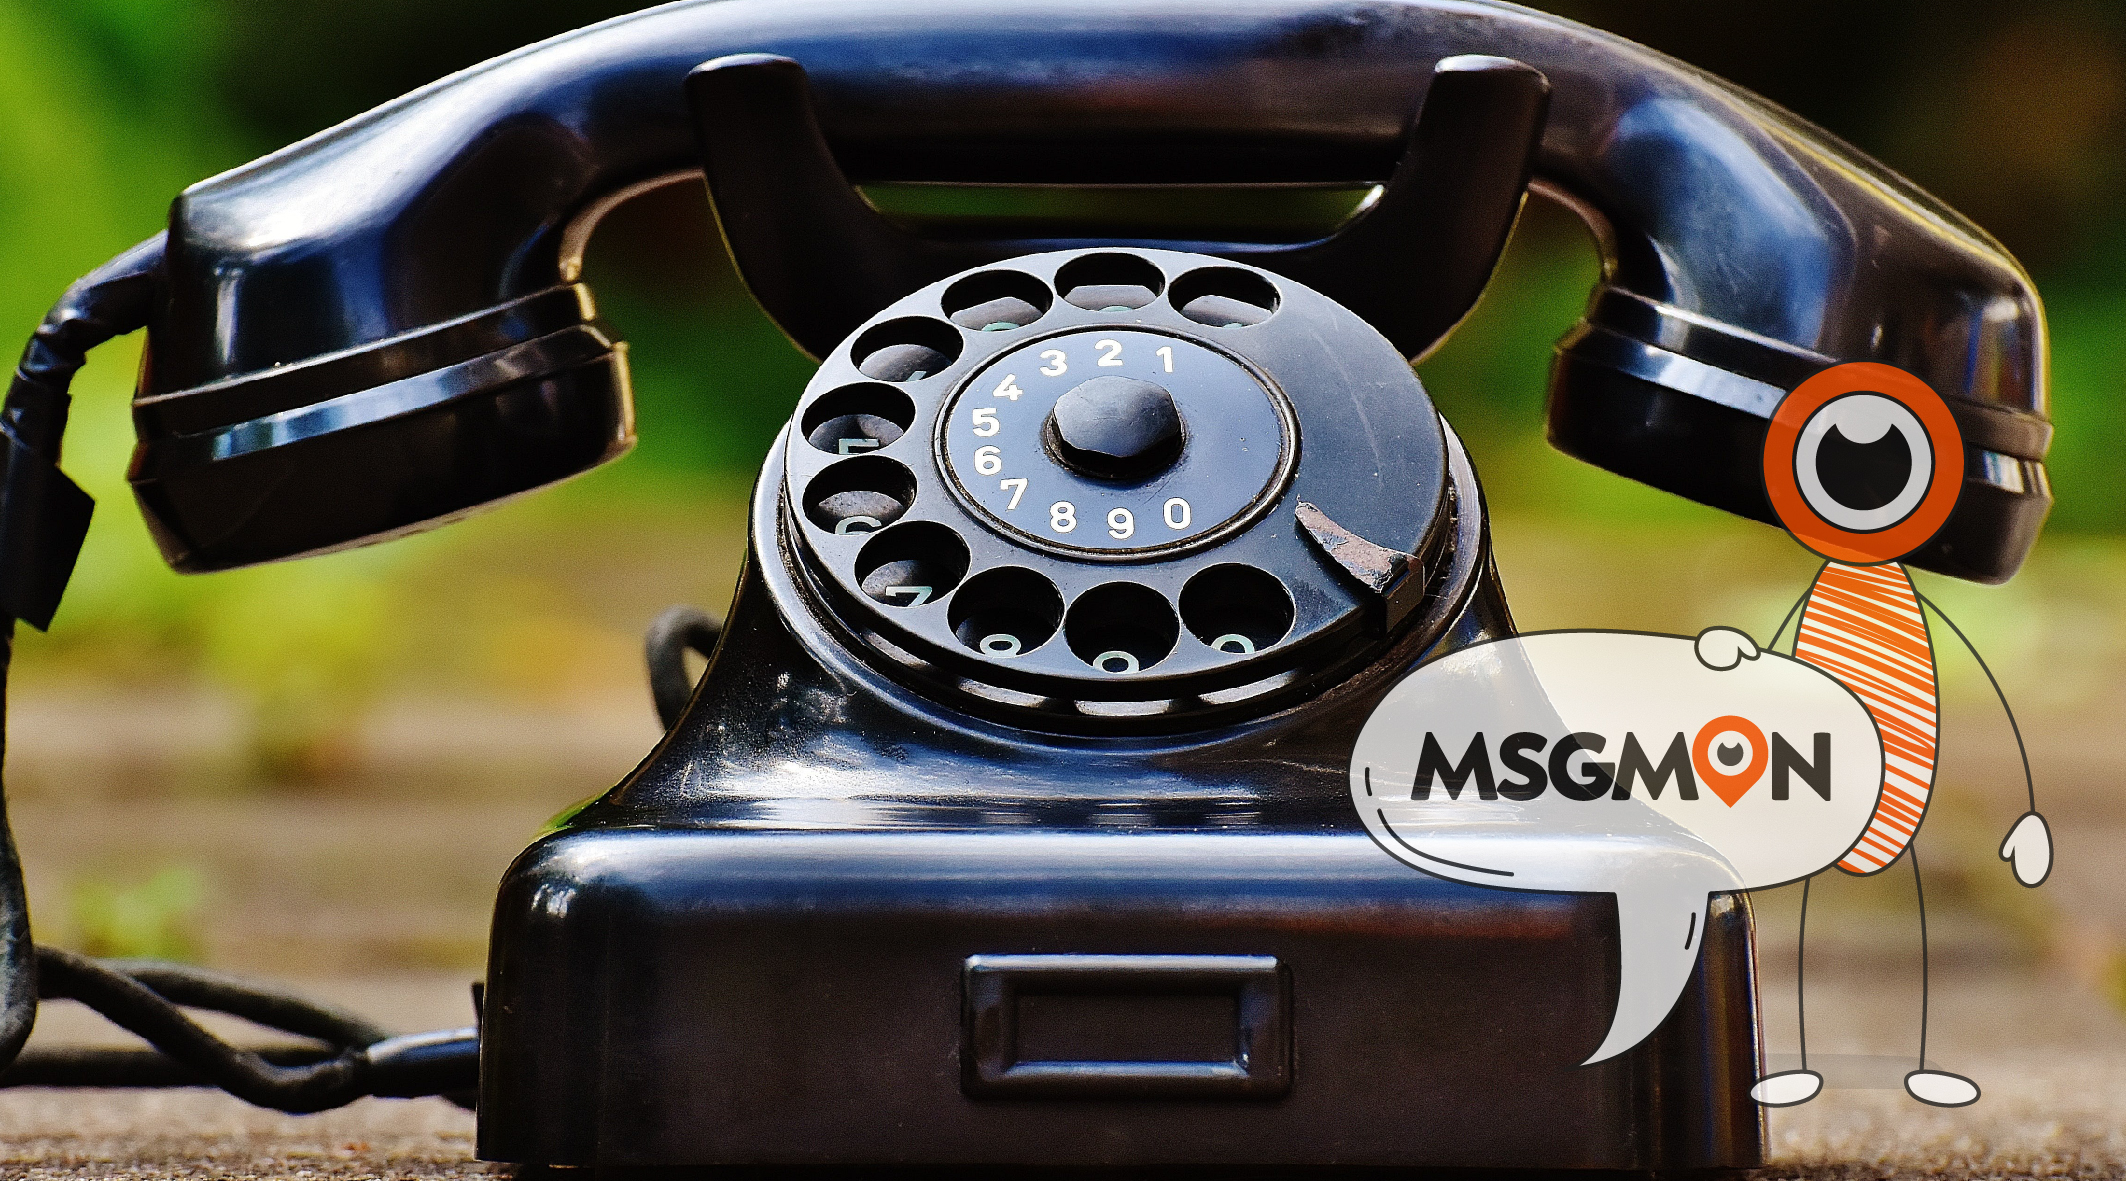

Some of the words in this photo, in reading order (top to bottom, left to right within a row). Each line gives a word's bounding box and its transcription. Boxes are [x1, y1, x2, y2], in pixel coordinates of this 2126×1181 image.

[1039, 349, 1068, 377] 3
[1094, 338, 1124, 367] 2
[1155, 346, 1174, 373] 1
[992, 373, 1023, 401] 4
[972, 407, 1000, 437] 5
[974, 445, 1002, 475] 6
[1000, 477, 1028, 511] 7
[1049, 501, 1077, 533] 8
[1107, 507, 1135, 539] 9
[1163, 497, 1191, 530] 0
